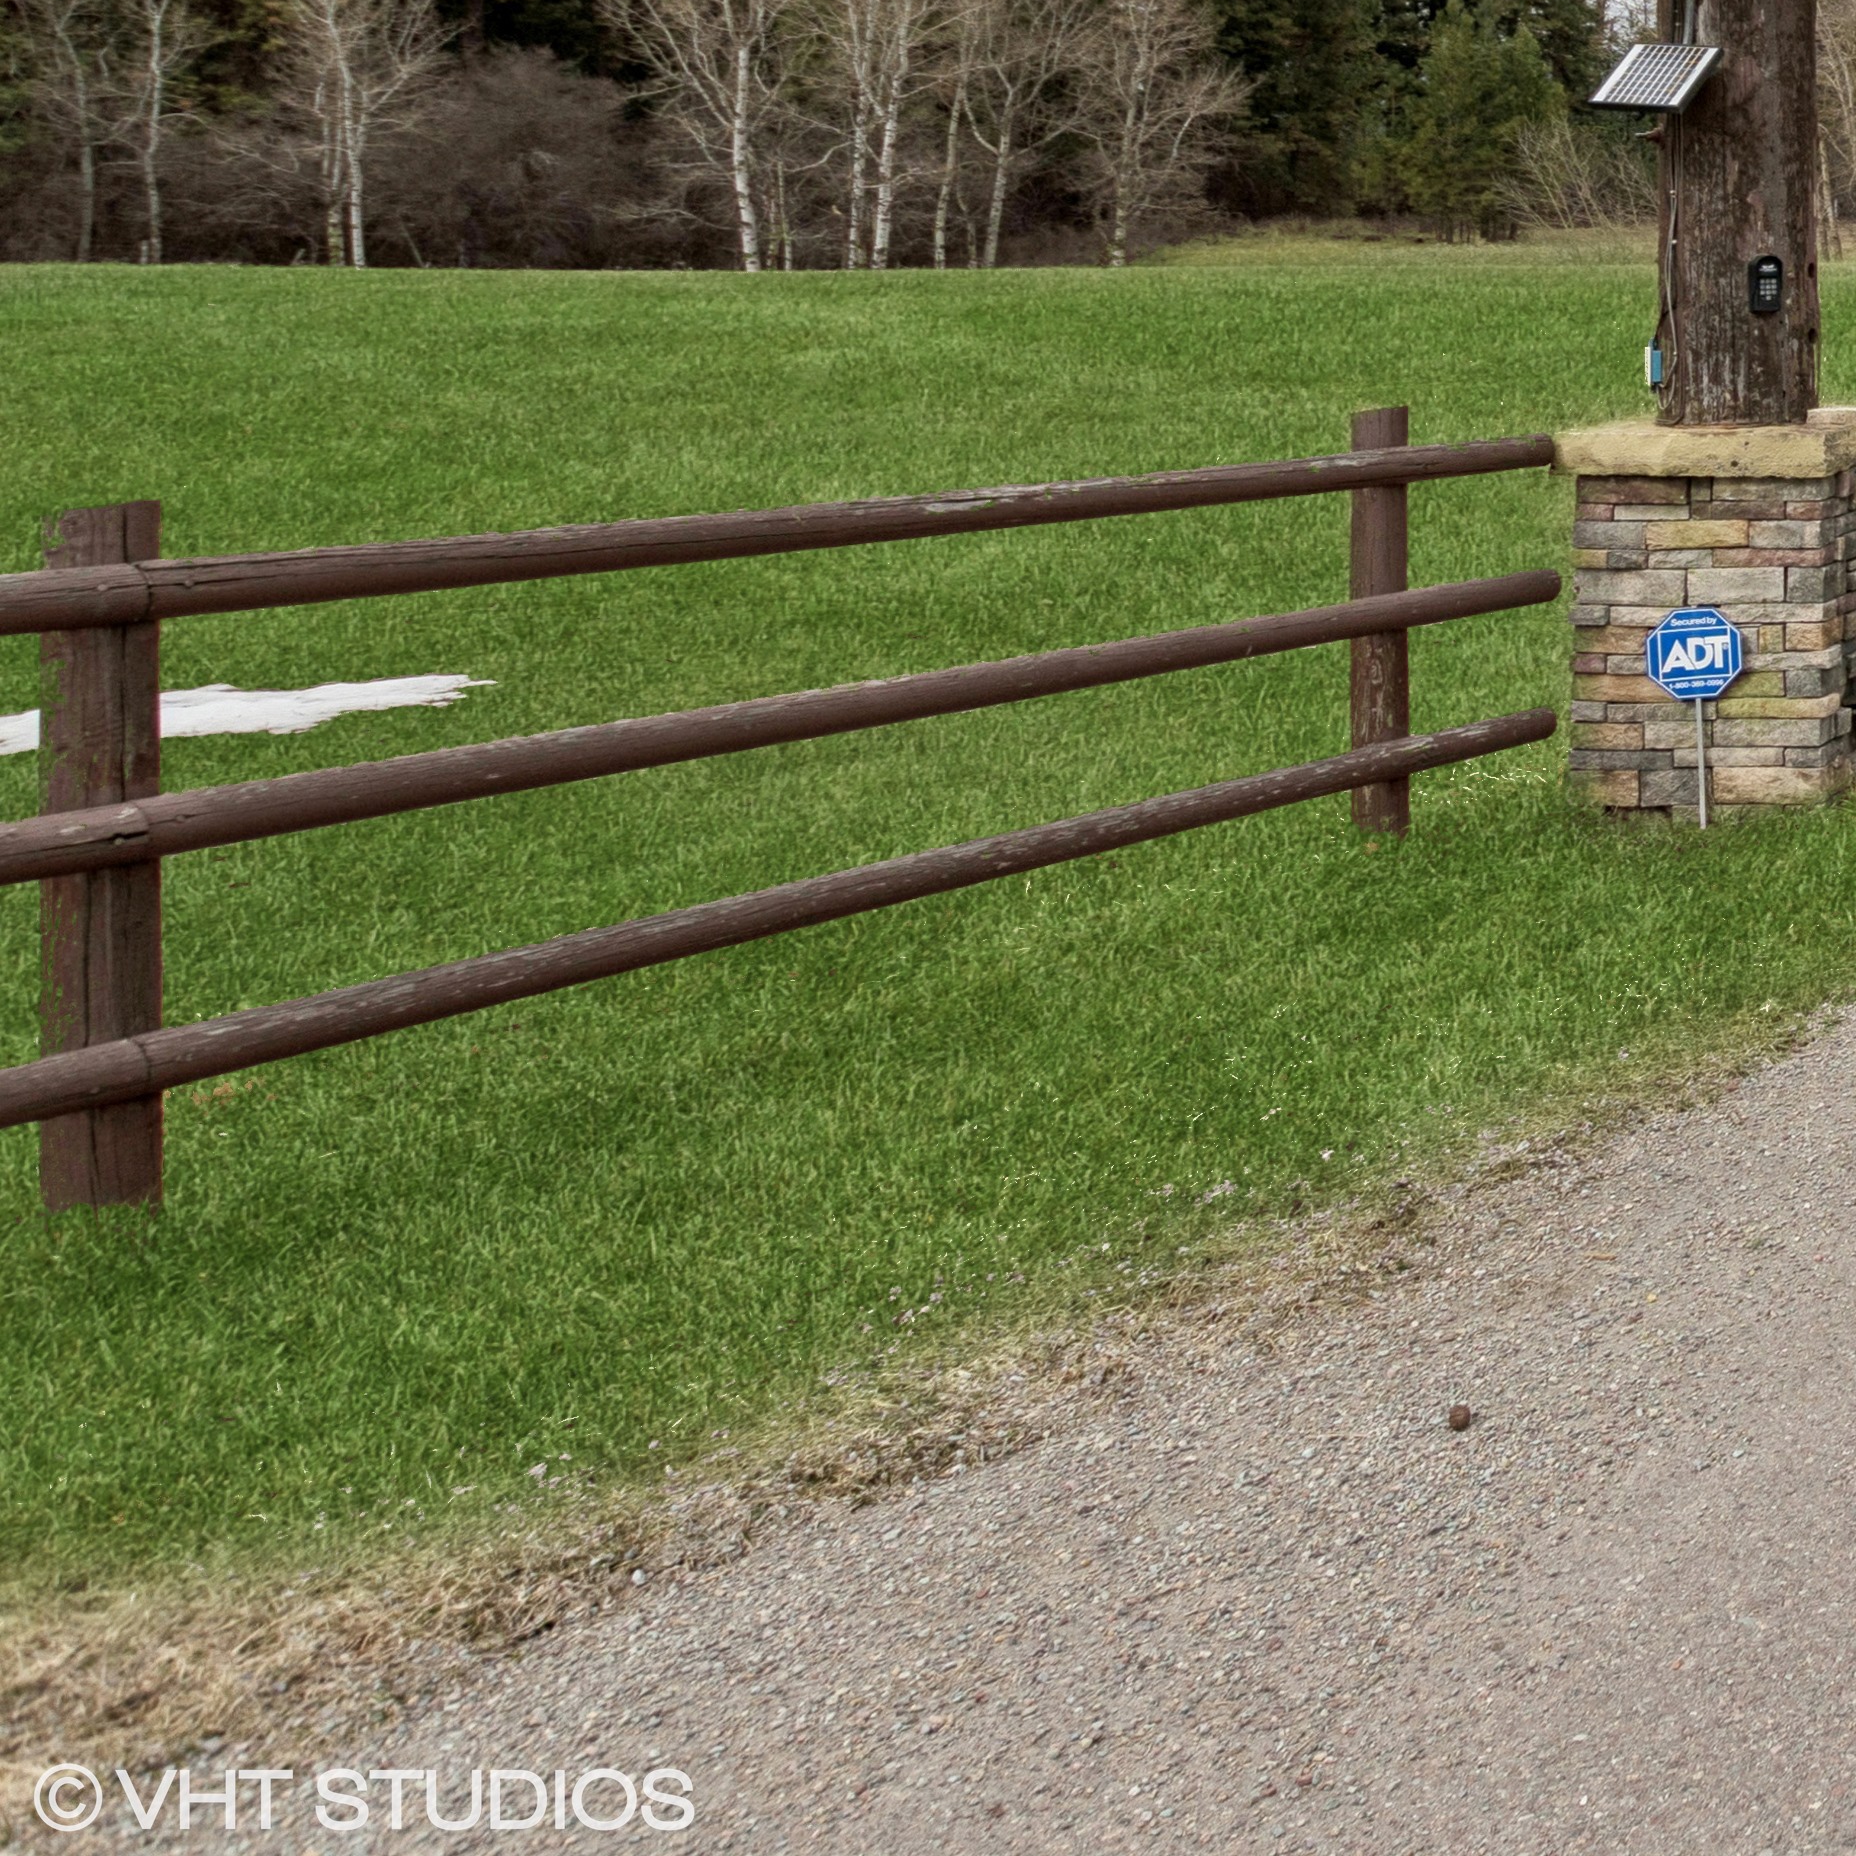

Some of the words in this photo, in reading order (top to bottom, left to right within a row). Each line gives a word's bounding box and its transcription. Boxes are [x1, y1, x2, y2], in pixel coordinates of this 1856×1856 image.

[1670, 617, 1706, 627] Secured
[1706, 616, 1718, 626] by
[1661, 635, 1729, 673] ADT
